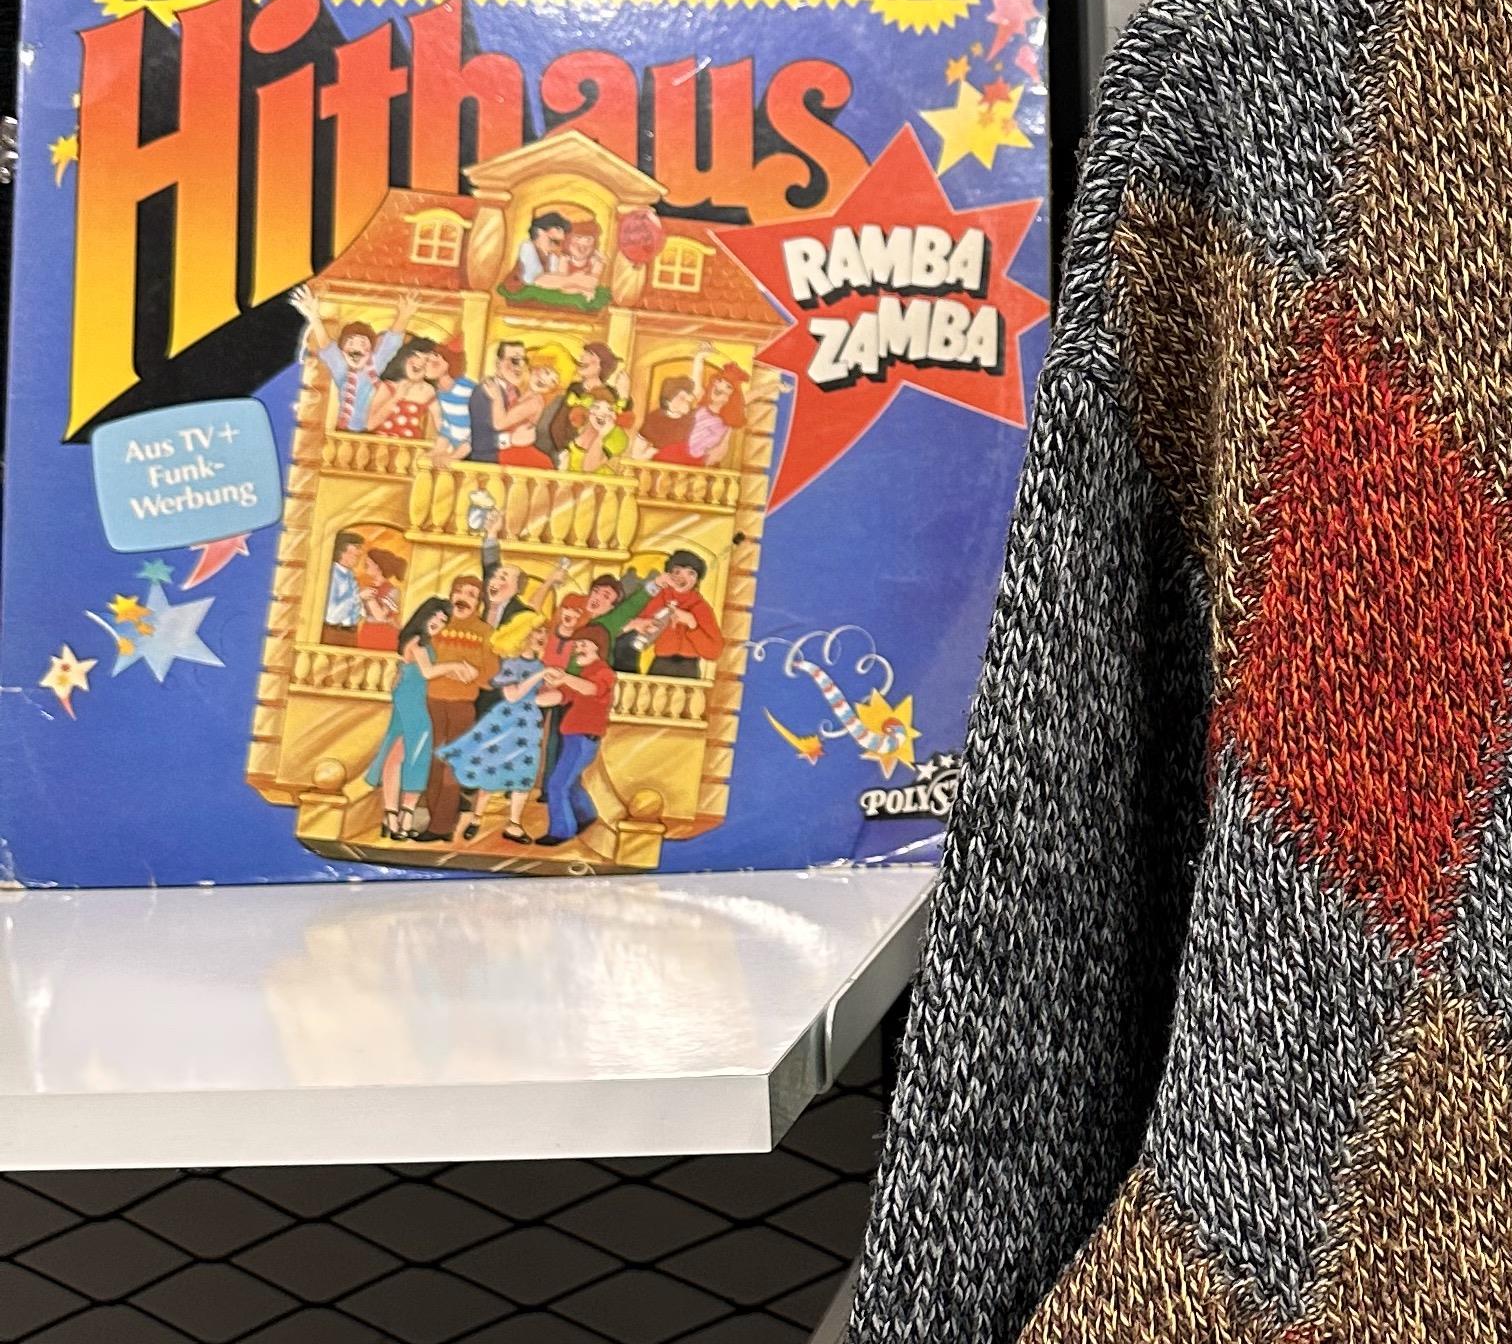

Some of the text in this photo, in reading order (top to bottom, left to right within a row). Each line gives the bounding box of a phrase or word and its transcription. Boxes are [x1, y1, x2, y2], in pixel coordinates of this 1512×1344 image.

[783, 224, 985, 302] RAMBA
[807, 296, 998, 384] ZAMBA
[125, 439, 175, 464] Aus
[148, 454, 225, 488] Funk-
[129, 481, 258, 520] Werbung
[860, 778, 958, 817] POLYS
